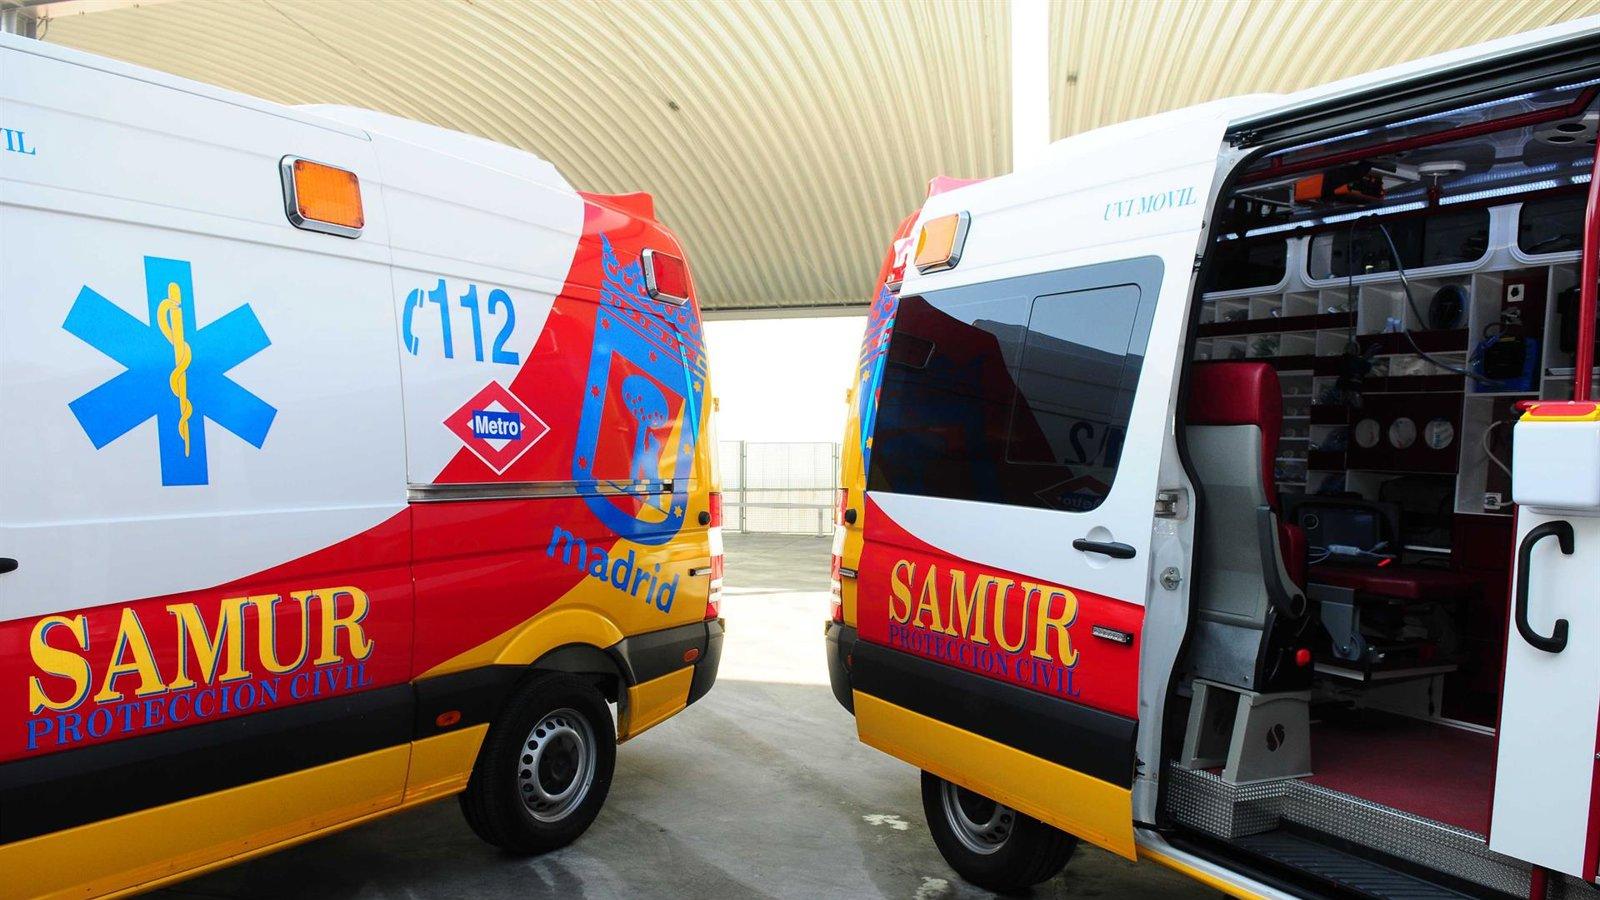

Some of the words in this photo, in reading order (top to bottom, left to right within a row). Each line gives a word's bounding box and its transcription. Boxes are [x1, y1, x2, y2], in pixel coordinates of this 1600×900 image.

[0, 127, 36, 155] IL
[1104, 199, 1134, 221] UVI
[1137, 186, 1197, 215] MOVIL
[428, 278, 520, 366] 112
[475, 415, 519, 436] Metro
[546, 524, 680, 614] madrid
[29, 585, 374, 715] SAMUR
[888, 559, 1079, 668] SAMUR
[889, 624, 1009, 676] PROTECCION
[1015, 657, 1081, 697] CIVIL
[25, 678, 280, 750] PROTECCION
[290, 663, 374, 699] CIVIL
